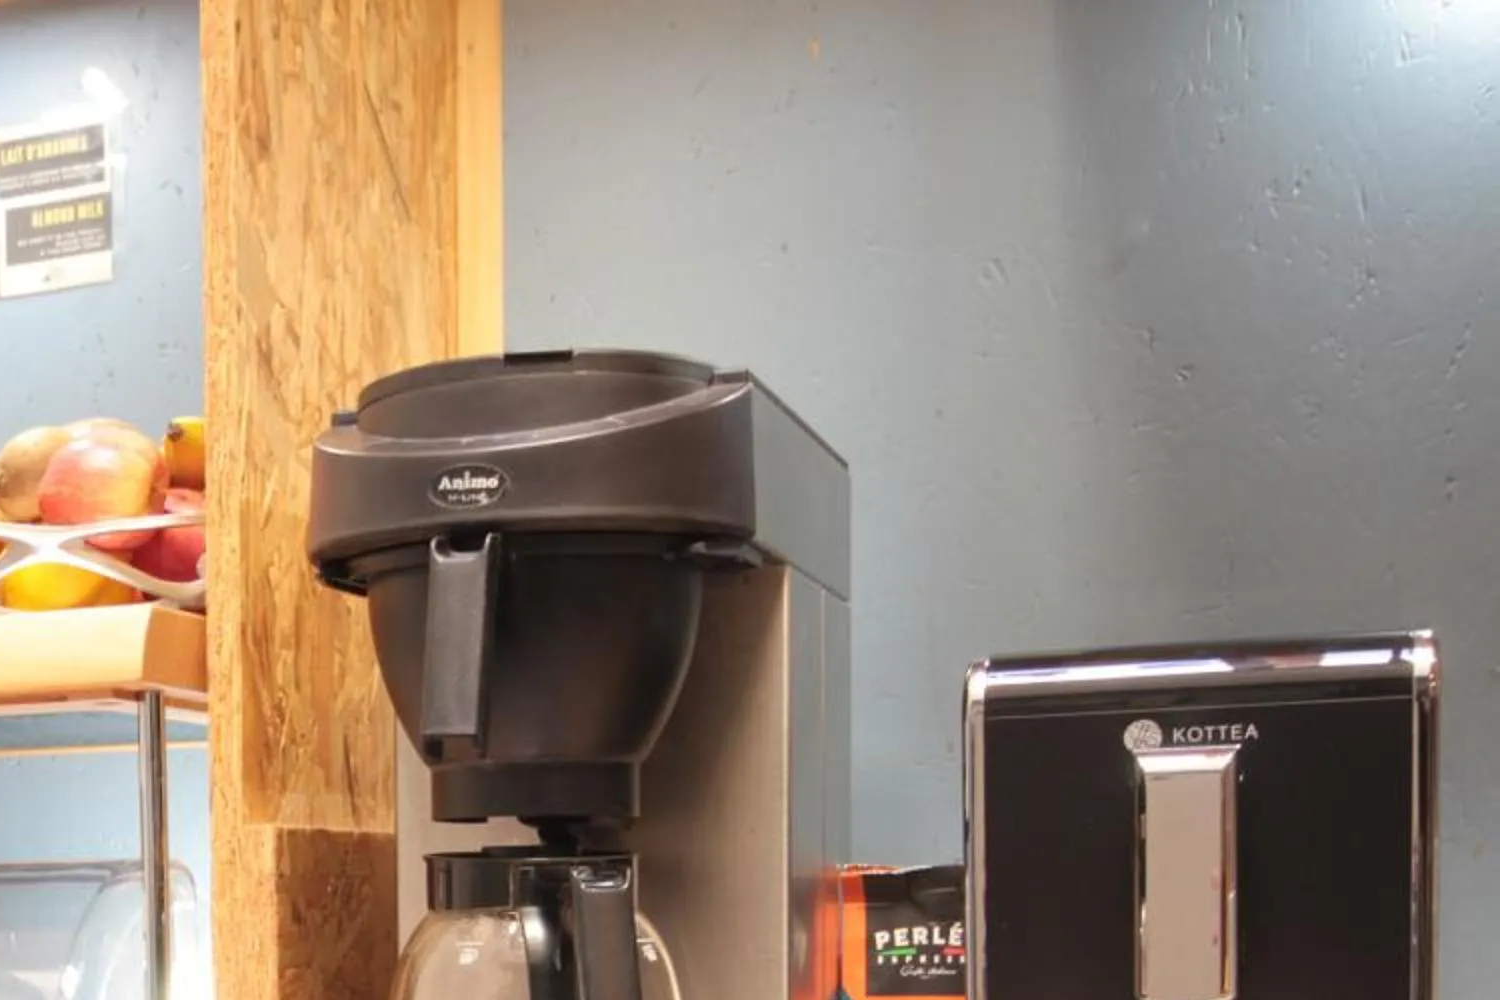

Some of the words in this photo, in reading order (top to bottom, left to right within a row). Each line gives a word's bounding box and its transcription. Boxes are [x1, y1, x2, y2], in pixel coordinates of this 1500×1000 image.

[437, 470, 500, 491] Animo
[1172, 723, 1260, 744] KOTTEA
[874, 921, 965, 950] PERLÉ
